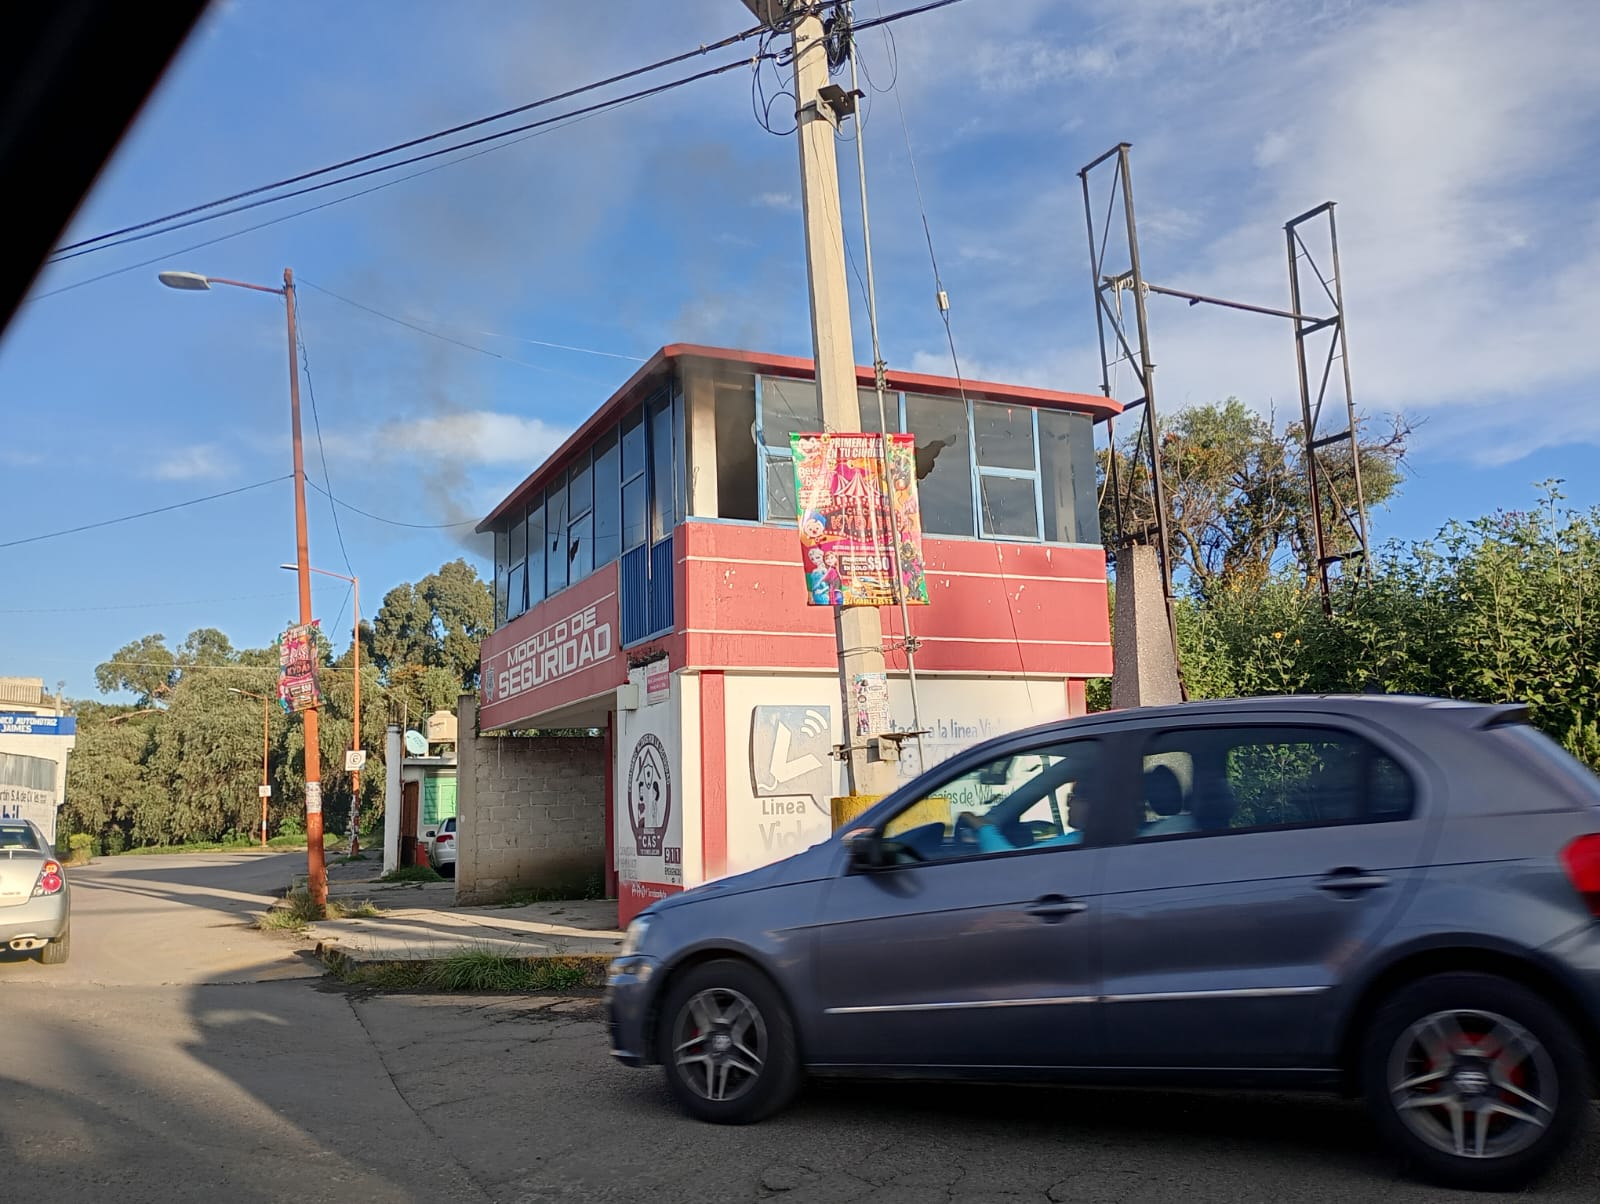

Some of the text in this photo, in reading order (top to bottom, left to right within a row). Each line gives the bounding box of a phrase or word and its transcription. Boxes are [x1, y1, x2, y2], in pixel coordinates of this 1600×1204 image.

[507, 606, 597, 668] MODULO DE
[498, 622, 611, 699] SEGURIDAD
[937, 719, 948, 738] la
[762, 799, 806, 815] Linea
[665, 848, 680, 862] 911
